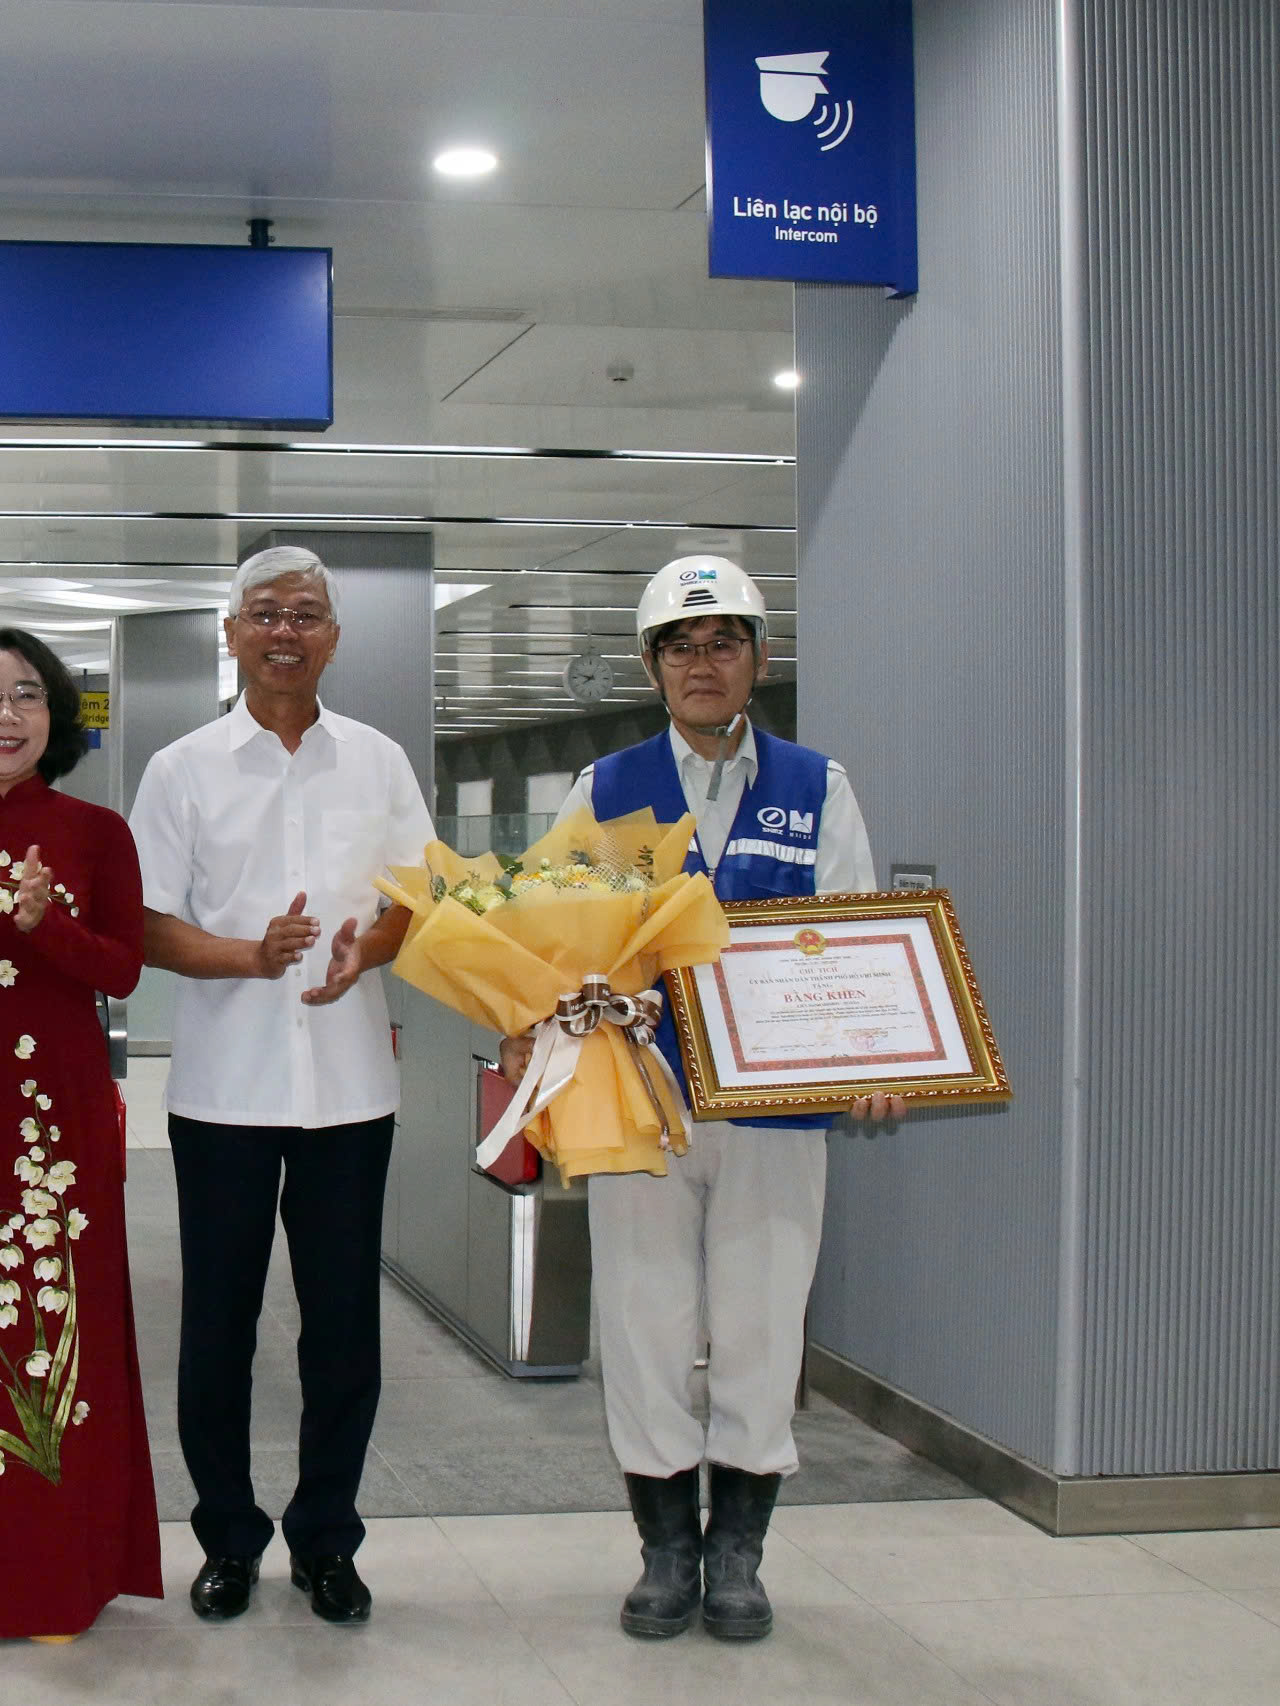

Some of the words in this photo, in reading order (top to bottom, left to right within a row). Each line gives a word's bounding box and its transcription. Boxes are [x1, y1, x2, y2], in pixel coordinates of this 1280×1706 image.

[733, 196, 777, 219] Liên
[783, 200, 812, 225] lạc
[817, 203, 847, 227] nội
[854, 203, 878, 229] bộ
[775, 226, 838, 243] Intercom
[826, 988, 867, 1001] KHEN
